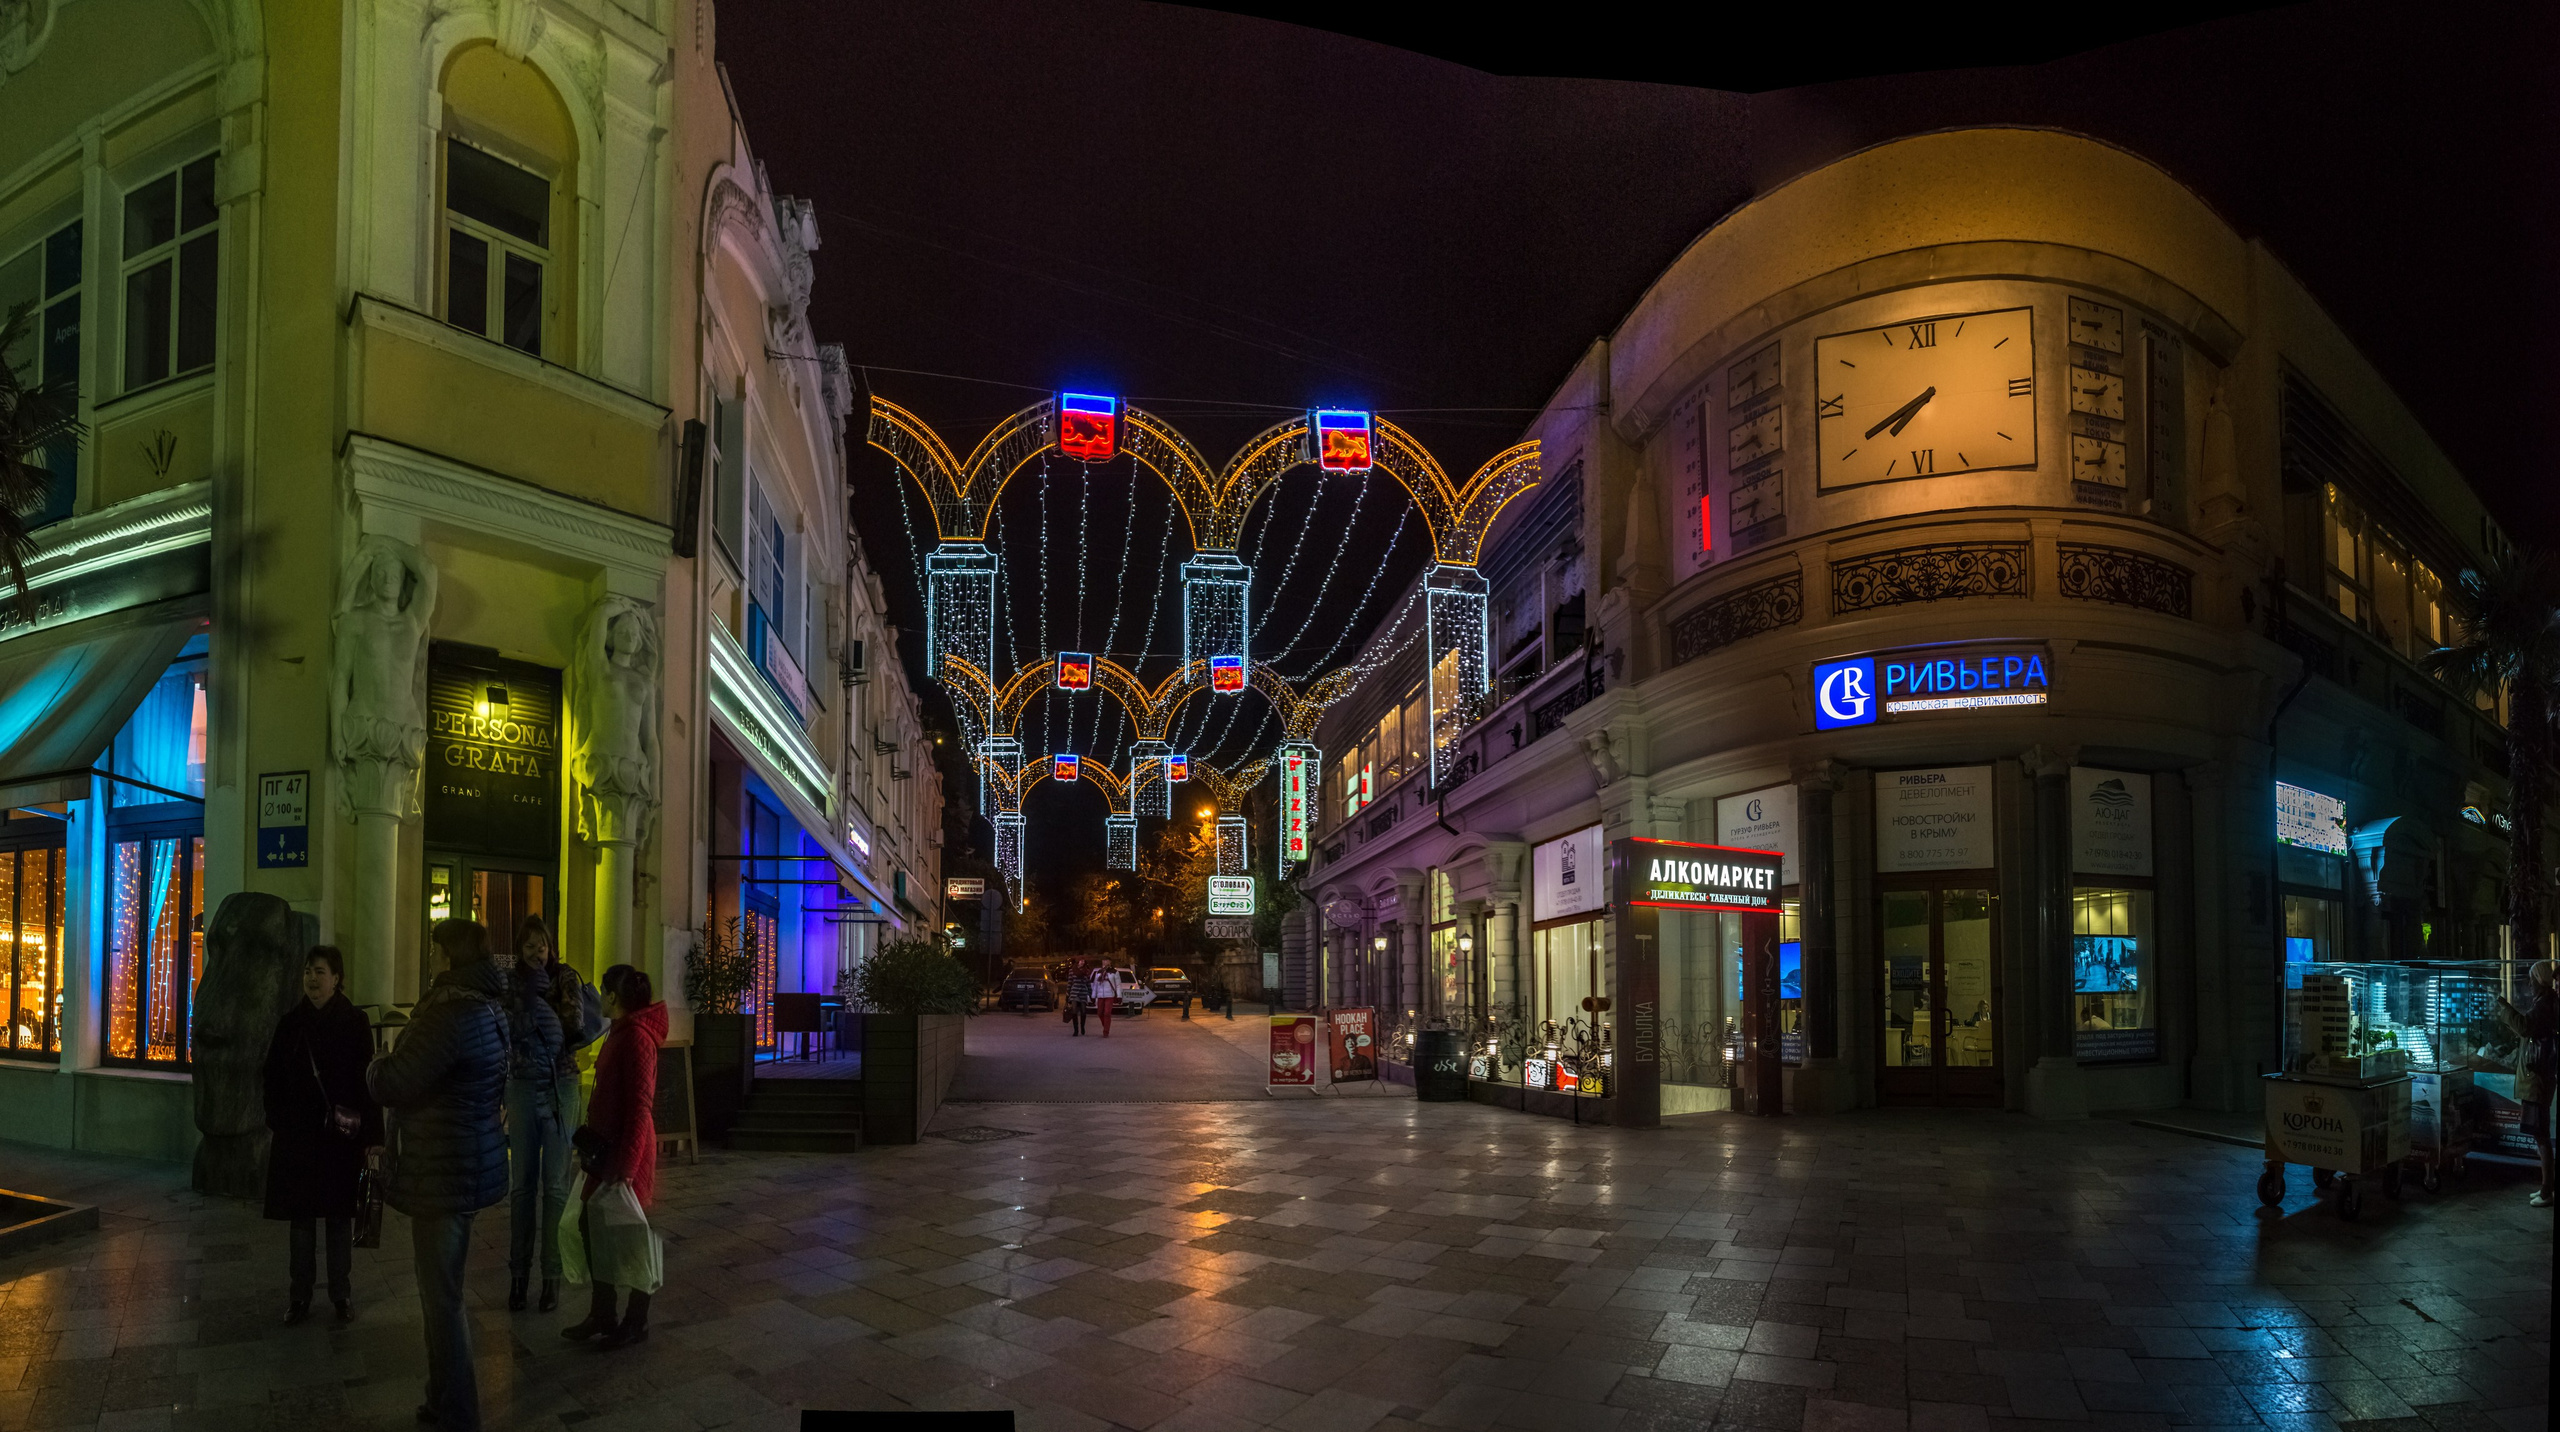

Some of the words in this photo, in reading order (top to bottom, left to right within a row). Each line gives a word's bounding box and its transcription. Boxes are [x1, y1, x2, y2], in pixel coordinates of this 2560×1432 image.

[1908, 322, 1937, 350] XII
[2086, 428, 2111, 440] TOKYO
[1911, 449, 1935, 475] VI
[1743, 468, 1772, 486] LONDON
[2076, 495, 2123, 510] WASHINGTON
[1886, 654, 2048, 695] РИВЬЕРА
[1886, 698, 1949, 714] крымская
[1954, 694, 2047, 712] недвижимость
[432, 708, 553, 750] PERSONA
[444, 744, 542, 779] GRATA
[265, 780, 283, 796] ПГ
[286, 778, 302, 794] 47
[1899, 774, 1946, 785] РИВЬЕРА
[442, 785, 481, 798] GRAND
[513, 794, 543, 806] CAFE
[1899, 786, 1976, 801] ДЕВЕЛОПМЕНТ
[276, 802, 292, 815] 100
[1892, 812, 1976, 826] НОВОСТРОЙКИ
[1730, 826, 1753, 837] ГУРЗУФ
[1753, 821, 1780, 832] РИВЬЕРА
[1910, 829, 1918, 839] В
[1920, 828, 1957, 839] КРЫМУ
[279, 852, 284, 862] 4
[299, 851, 306, 861] 5
[1900, 851, 1906, 859] 8
[1907, 850, 1924, 859] 800
[1926, 849, 1942, 858] 775
[1945, 849, 1955, 857] 75
[1957, 848, 1969, 857] 97
[1649, 858, 1775, 890] АЛКОМАРКЕТ
[1650, 889, 1707, 902] ДЕЛИКАТЕСЫ
[1709, 893, 1750, 905] ТАБАЧНЫЙ
[1751, 896, 1768, 906] ДОМ
[1206, 925, 1250, 938] ЗООПАРК
[1335, 1012, 1367, 1025] HOOKAH
[1340, 1023, 1365, 1035] PLACE
[1635, 1001, 1654, 1062] БУТЫЛКА
[1434, 1059, 1458, 1073] esse
[2283, 1112, 2344, 1133] КОРОНА
[2292, 1141, 2307, 1150] 978
[2307, 1143, 2322, 1153] 018
[2322, 1146, 2333, 1154] 42
[2333, 1147, 2343, 1156] 30
